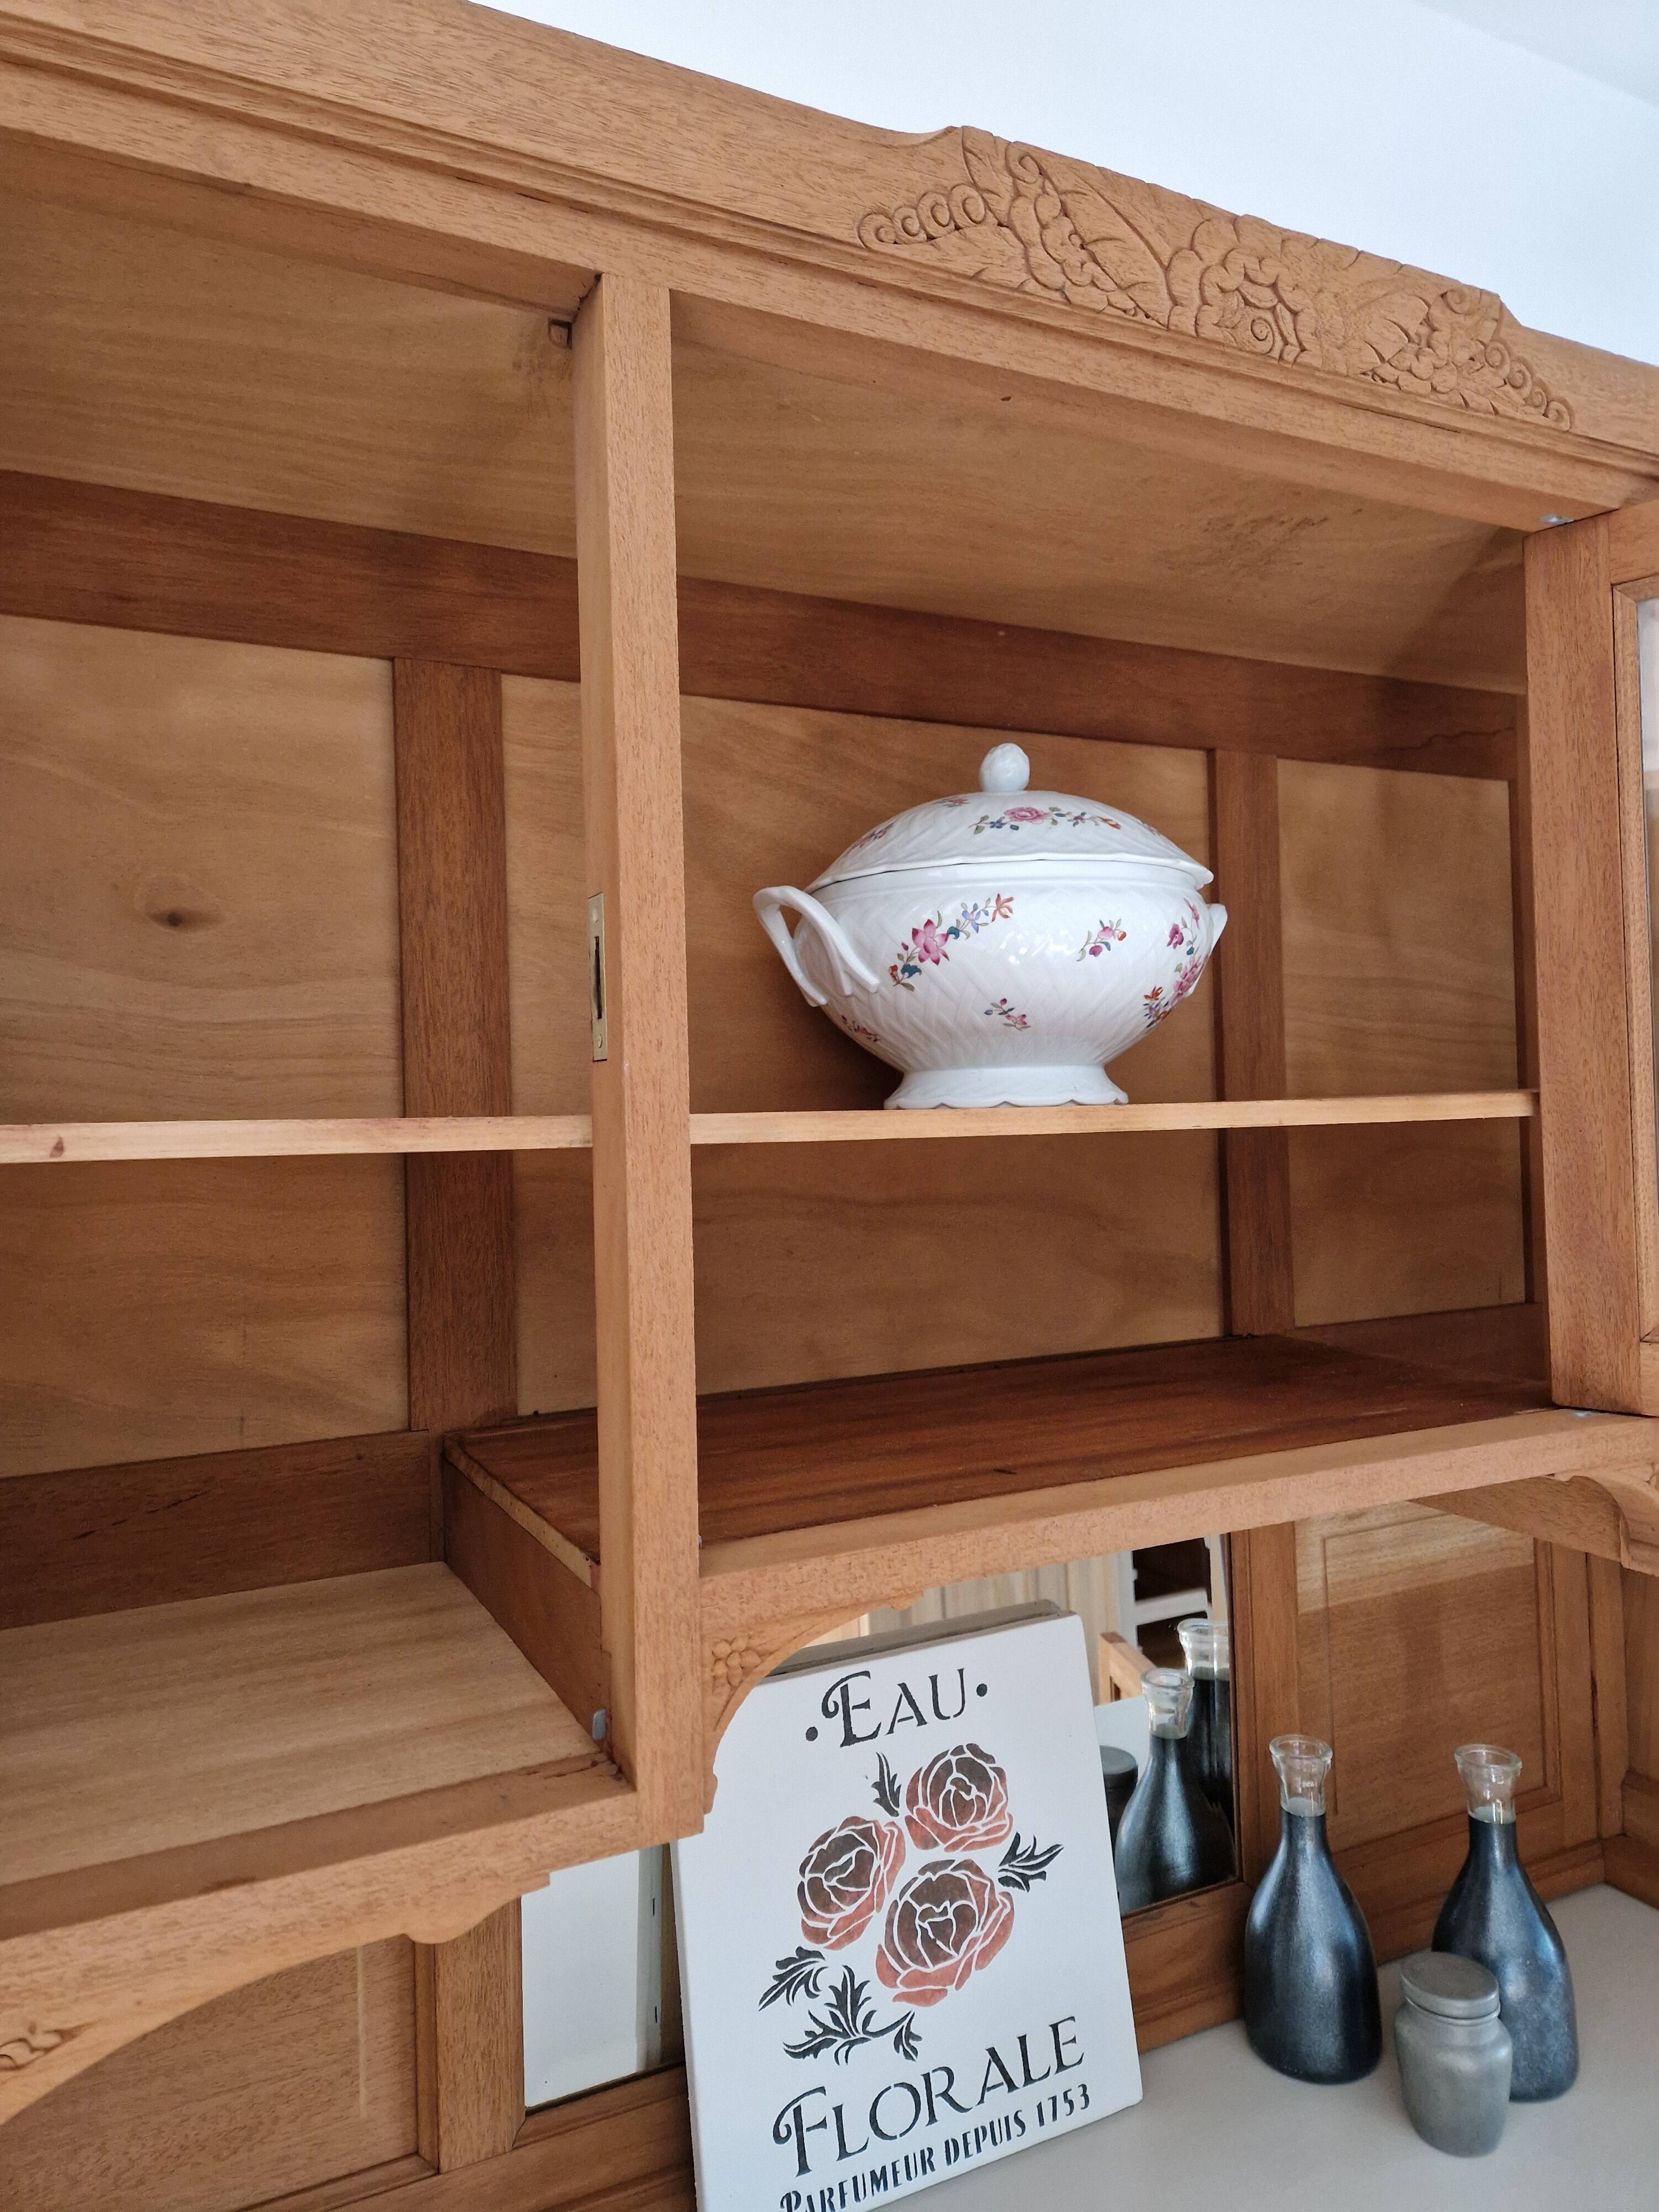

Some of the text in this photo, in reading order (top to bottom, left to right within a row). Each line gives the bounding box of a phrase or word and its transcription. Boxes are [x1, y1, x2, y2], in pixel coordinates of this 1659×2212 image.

[773, 2016, 1084, 2177] FLORALE
[780, 2084, 1091, 2212] PARFUMEUR DEPUIS 1753
